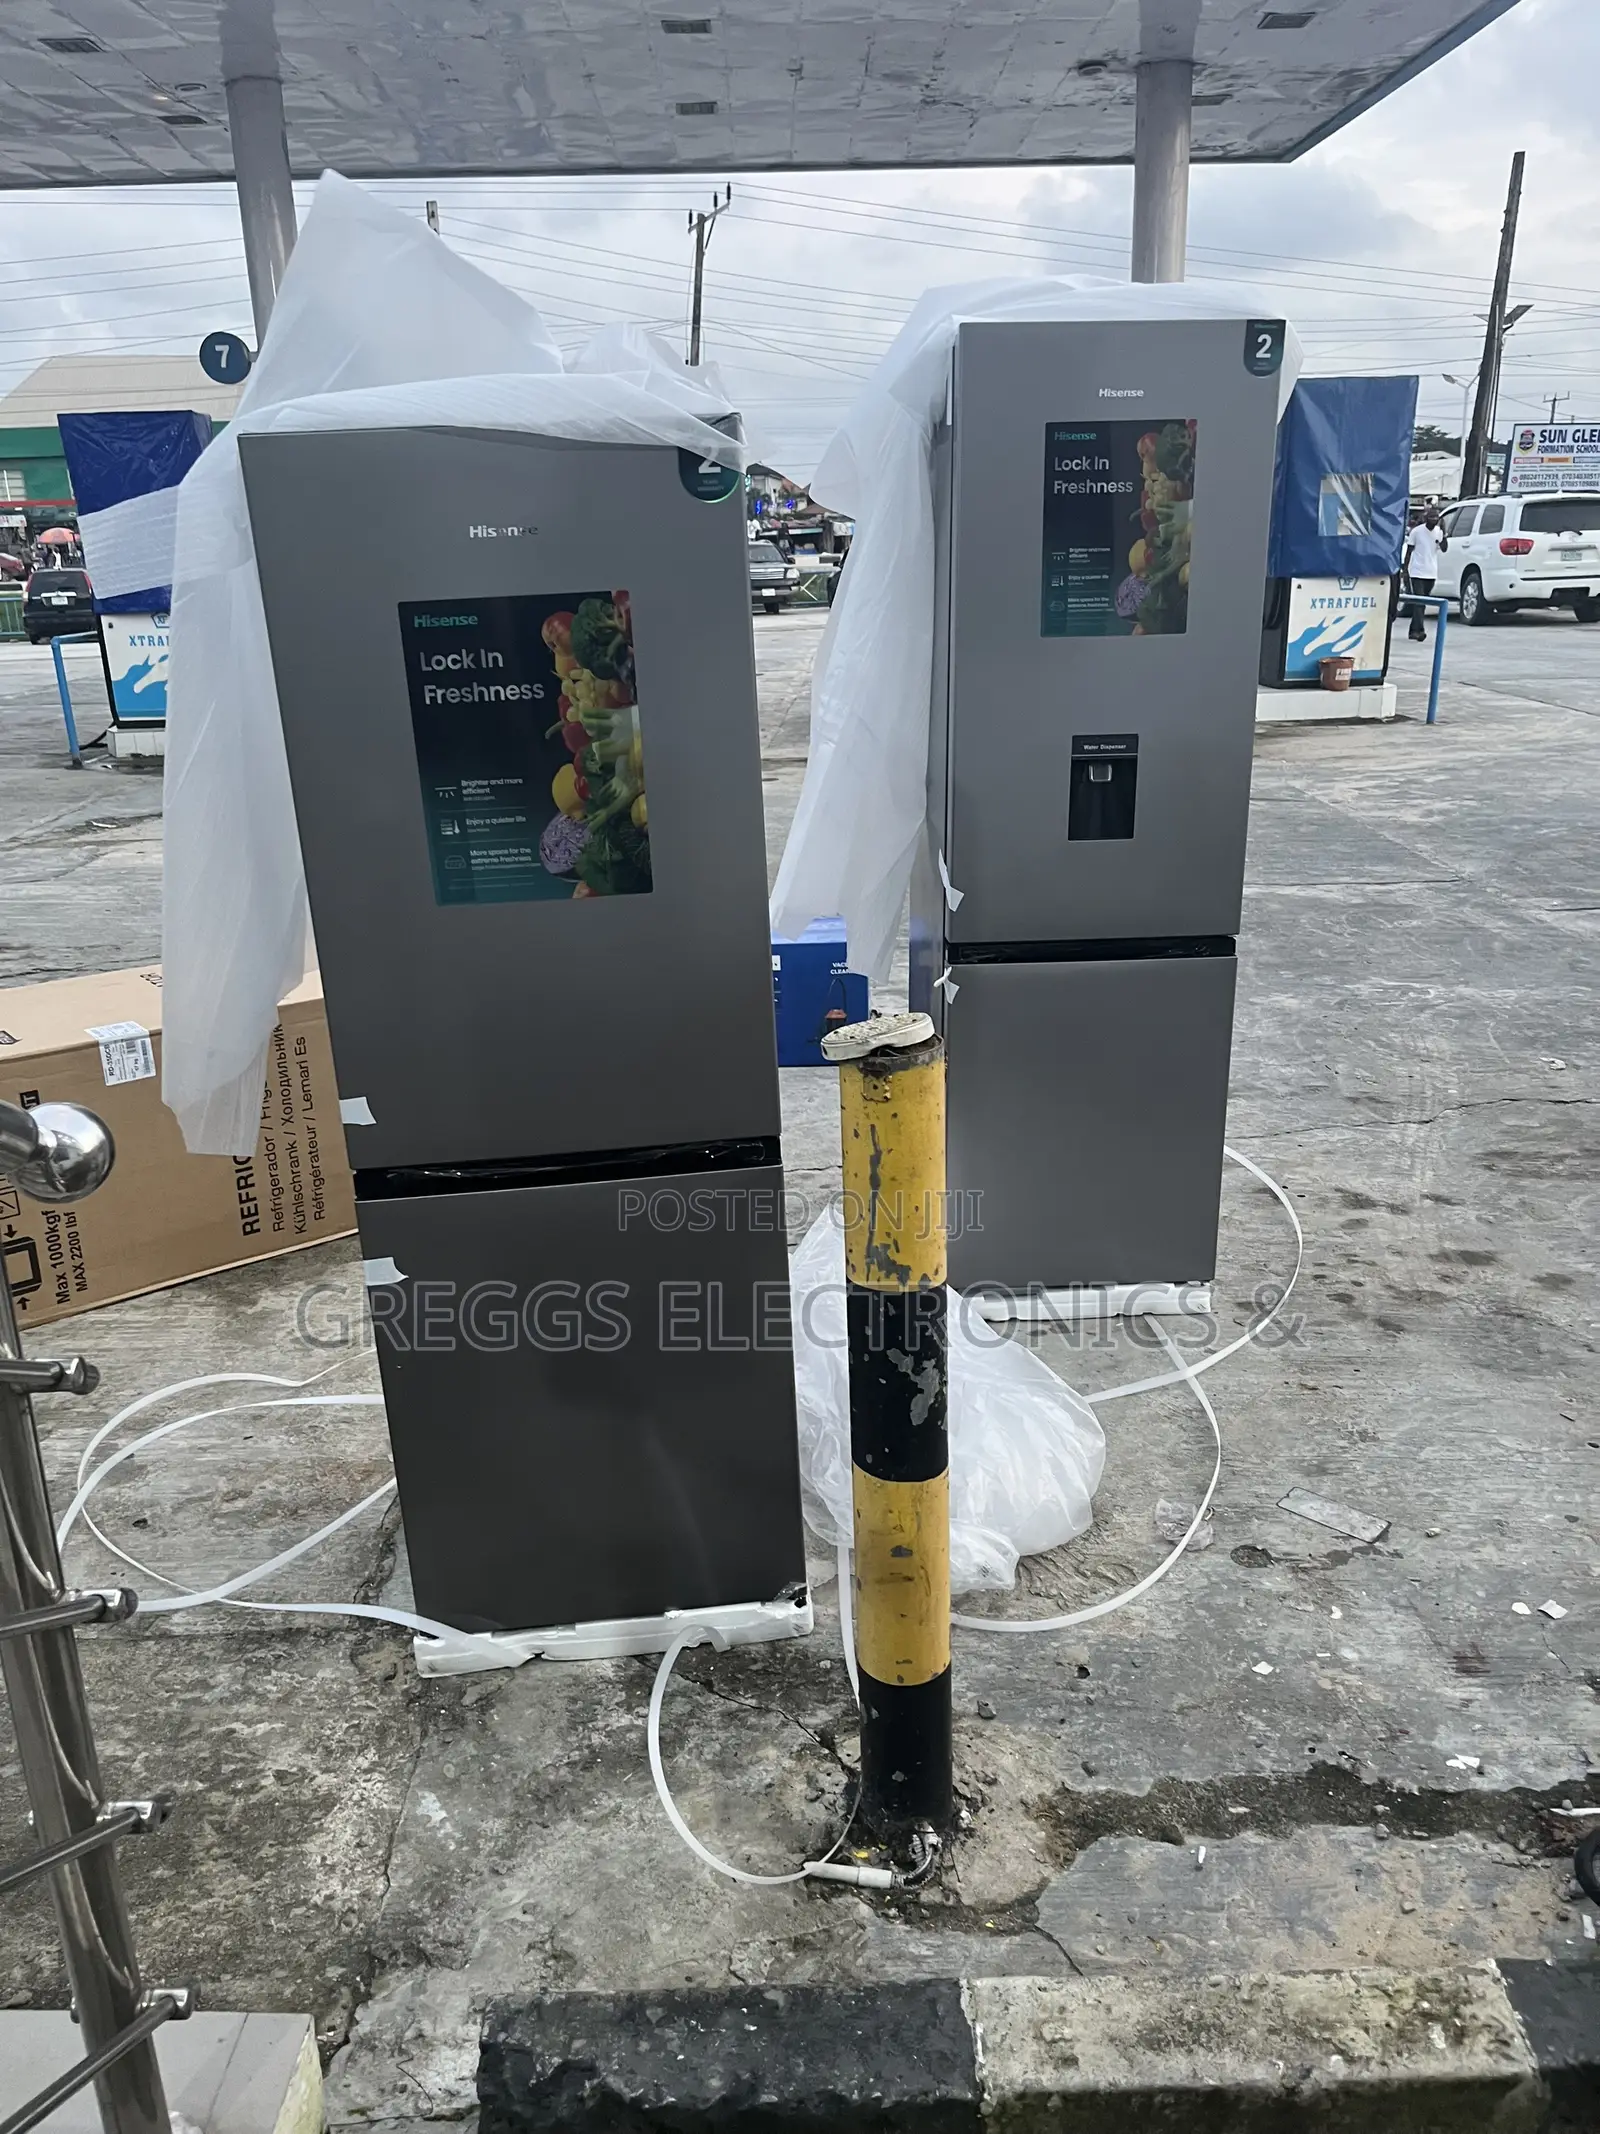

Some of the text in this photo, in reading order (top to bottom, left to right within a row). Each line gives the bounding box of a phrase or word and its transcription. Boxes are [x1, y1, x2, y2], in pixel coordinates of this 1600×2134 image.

[214, 344, 230, 369] 7
[1256, 334, 1272, 358] 2
[1098, 388, 1145, 398] Hisense
[1054, 431, 1097, 441] Hisense
[1539, 429, 1568, 444] SUN
[698, 441, 722, 474] 2
[1054, 456, 1110, 471] Lock In
[1053, 479, 1134, 494] Freshness
[1310, 597, 1377, 609] XTRAFUEL
[413, 614, 479, 628] Hisense
[420, 648, 504, 671] Lock In
[424, 682, 545, 705] Freshness
[294, 1036, 307, 1056] Es
[296, 1060, 314, 1112] Lemari
[263, 1136, 285, 1232] Refrigerador
[306, 1125, 326, 1220] Réfrigérateur
[284, 1140, 308, 1234] Kühlschrank
[41, 1209, 71, 1304] Max 1000kgf
[63, 1211, 88, 1292] MAX 2200 lbf
